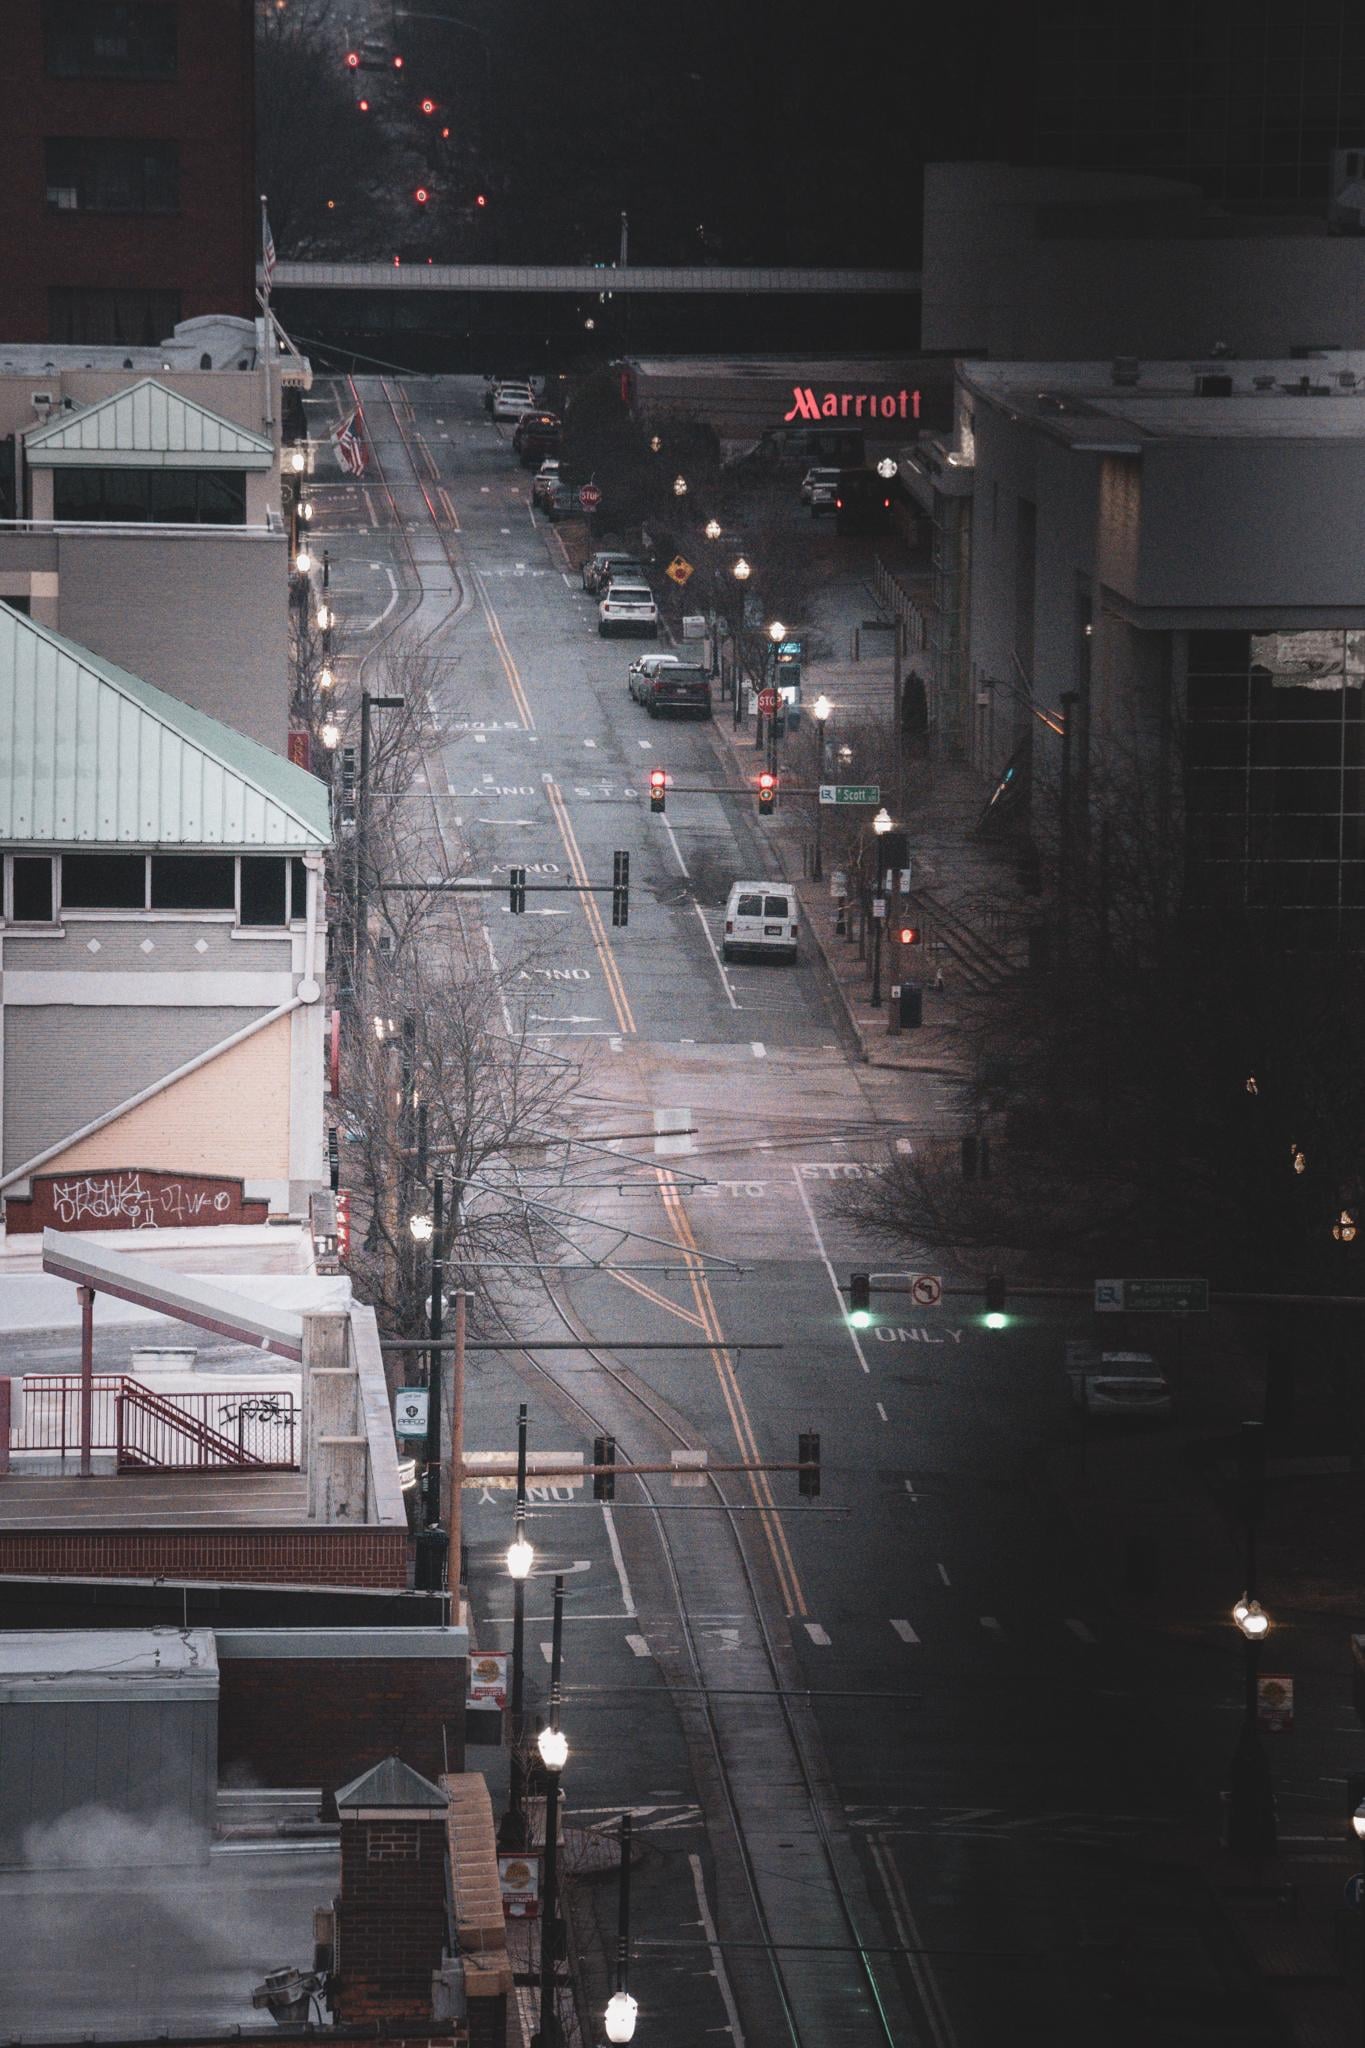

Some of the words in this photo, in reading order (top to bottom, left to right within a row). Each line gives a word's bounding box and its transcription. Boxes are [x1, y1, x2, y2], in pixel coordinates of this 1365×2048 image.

[784, 386, 921, 422] Marriott
[844, 790, 866, 801] Scott
[874, 1326, 963, 1344] ONLY
[478, 1487, 575, 1505] ONY
